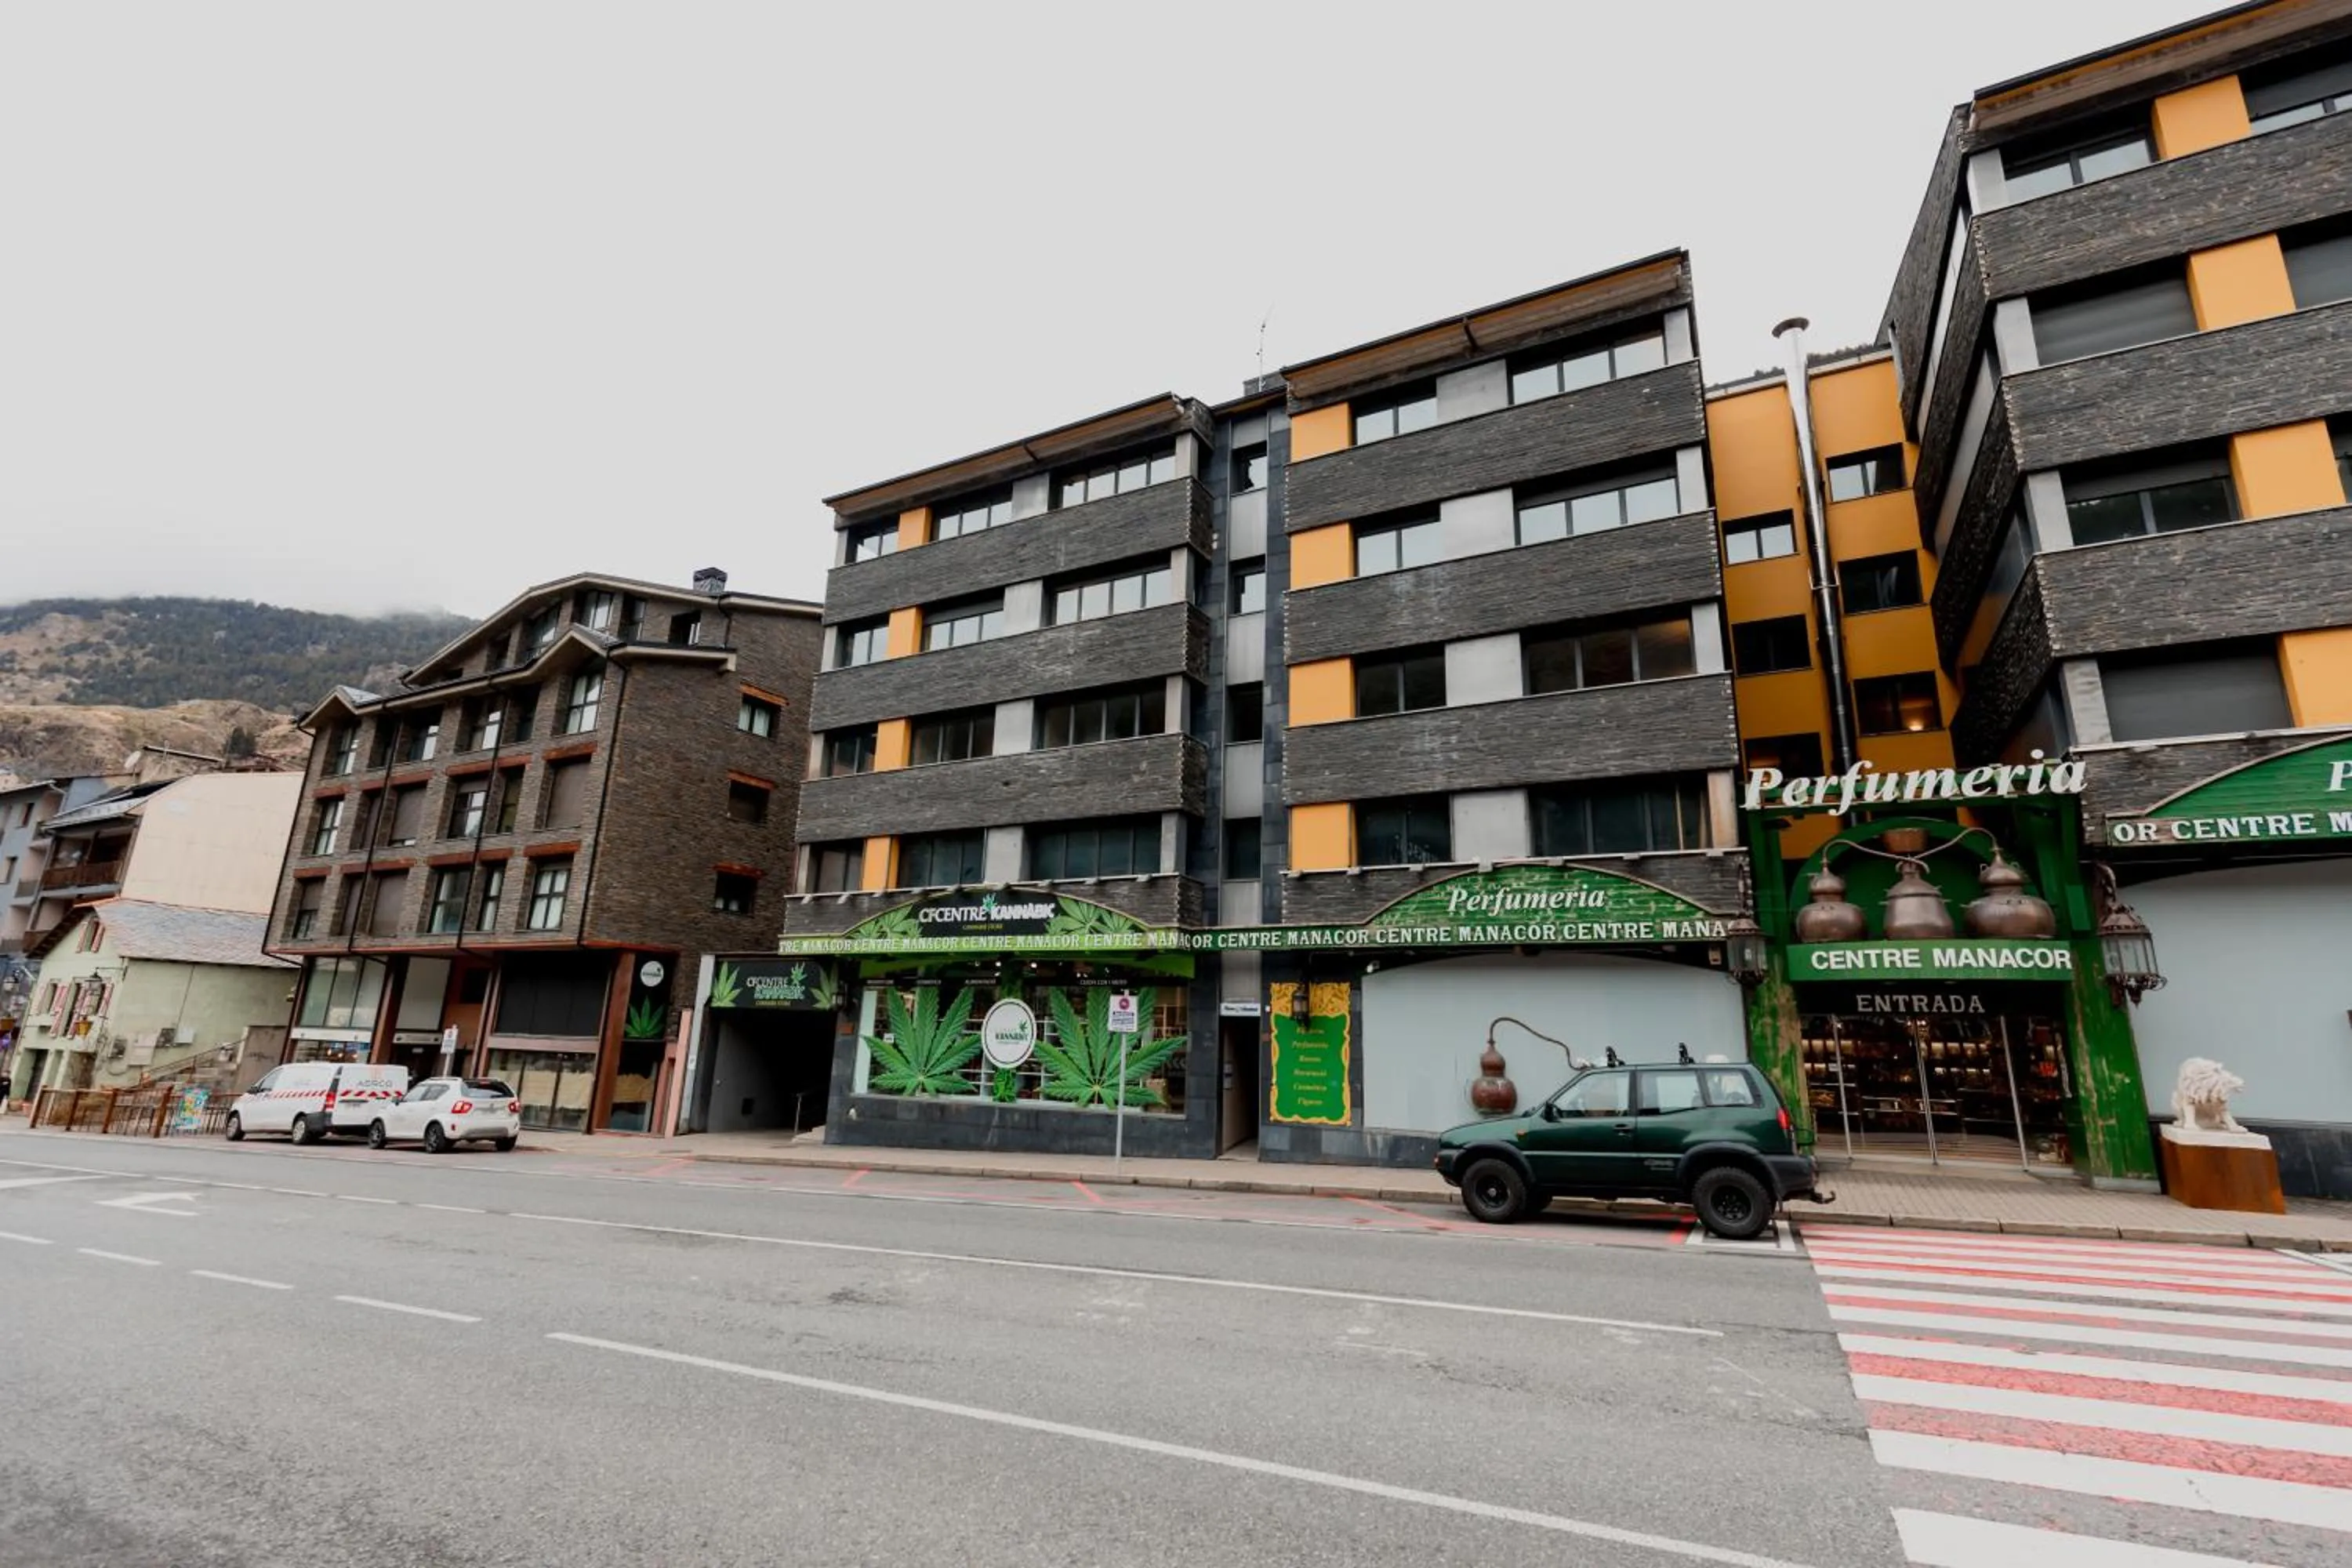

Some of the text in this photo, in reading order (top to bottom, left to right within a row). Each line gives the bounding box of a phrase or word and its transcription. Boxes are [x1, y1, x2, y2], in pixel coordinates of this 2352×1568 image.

[1740, 749, 2088, 816] Perfumeria
[2113, 822, 2158, 842] OR
[2171, 813, 2317, 840] CENTRE
[1447, 884, 1606, 915] Perfumeria
[962, 935, 1014, 948] CENTRE
[1084, 932, 1142, 946] CENTRE
[1218, 931, 1282, 948] CENTRE
[1287, 930, 1369, 946] MANACOR
[1376, 927, 1451, 943] CENTRE
[1458, 924, 1556, 942] MANACOR
[1563, 922, 1654, 940] CENTRE
[1811, 948, 2073, 970] CENTRE MANACOR
[1856, 994, 1985, 1013] ENTRADA
